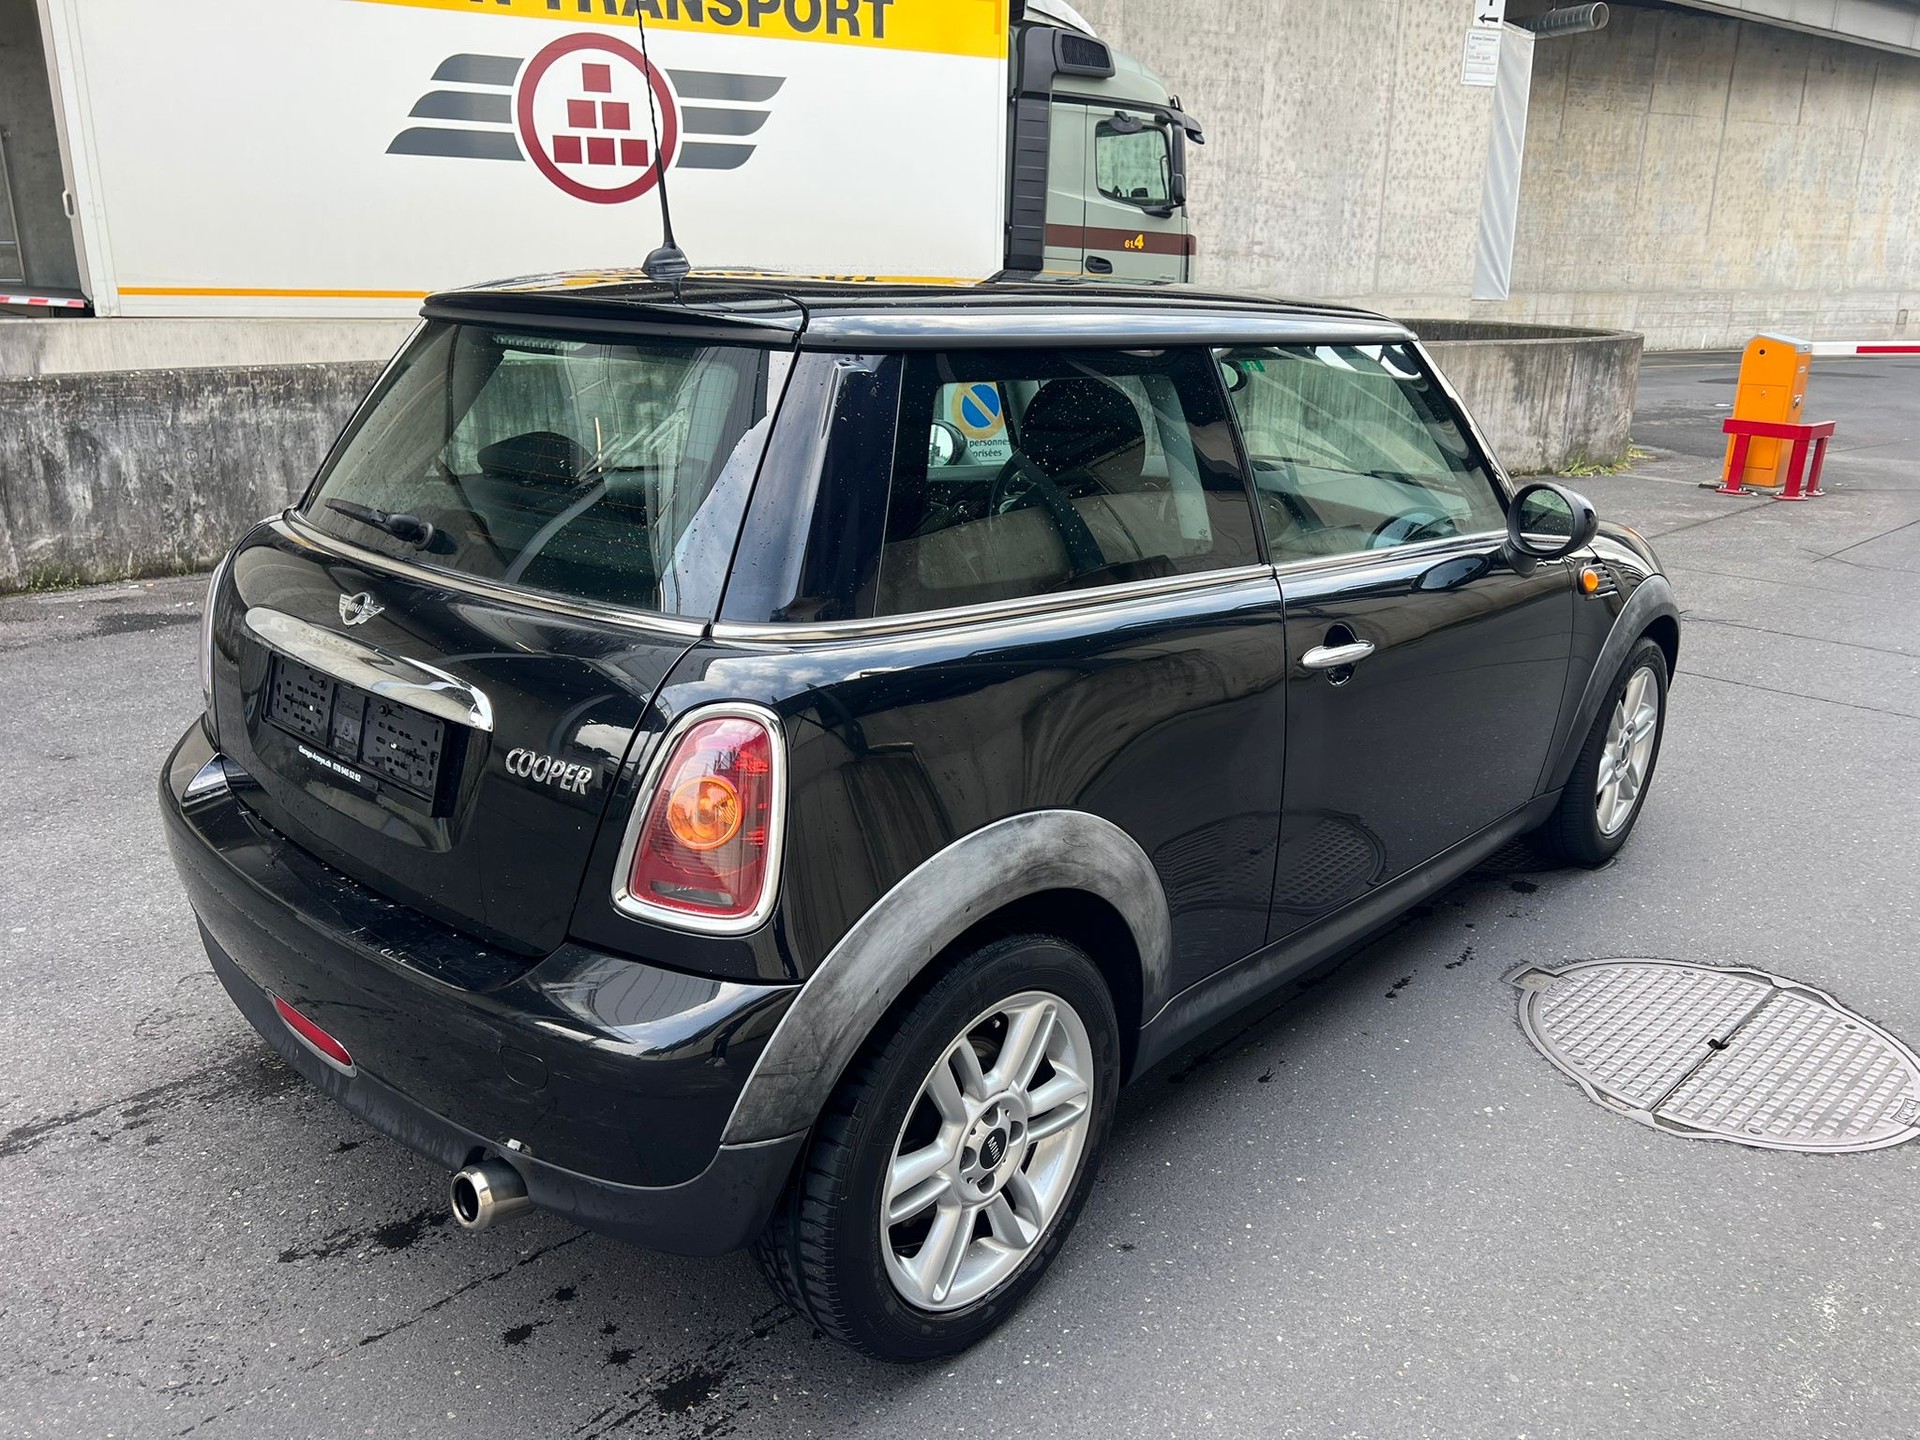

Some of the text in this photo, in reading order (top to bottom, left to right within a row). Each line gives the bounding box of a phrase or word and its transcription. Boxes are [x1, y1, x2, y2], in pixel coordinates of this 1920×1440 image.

[547, 0, 894, 39] NSPORT
[505, 747, 593, 795] COOPER
[987, 1136, 1001, 1162] MINI
